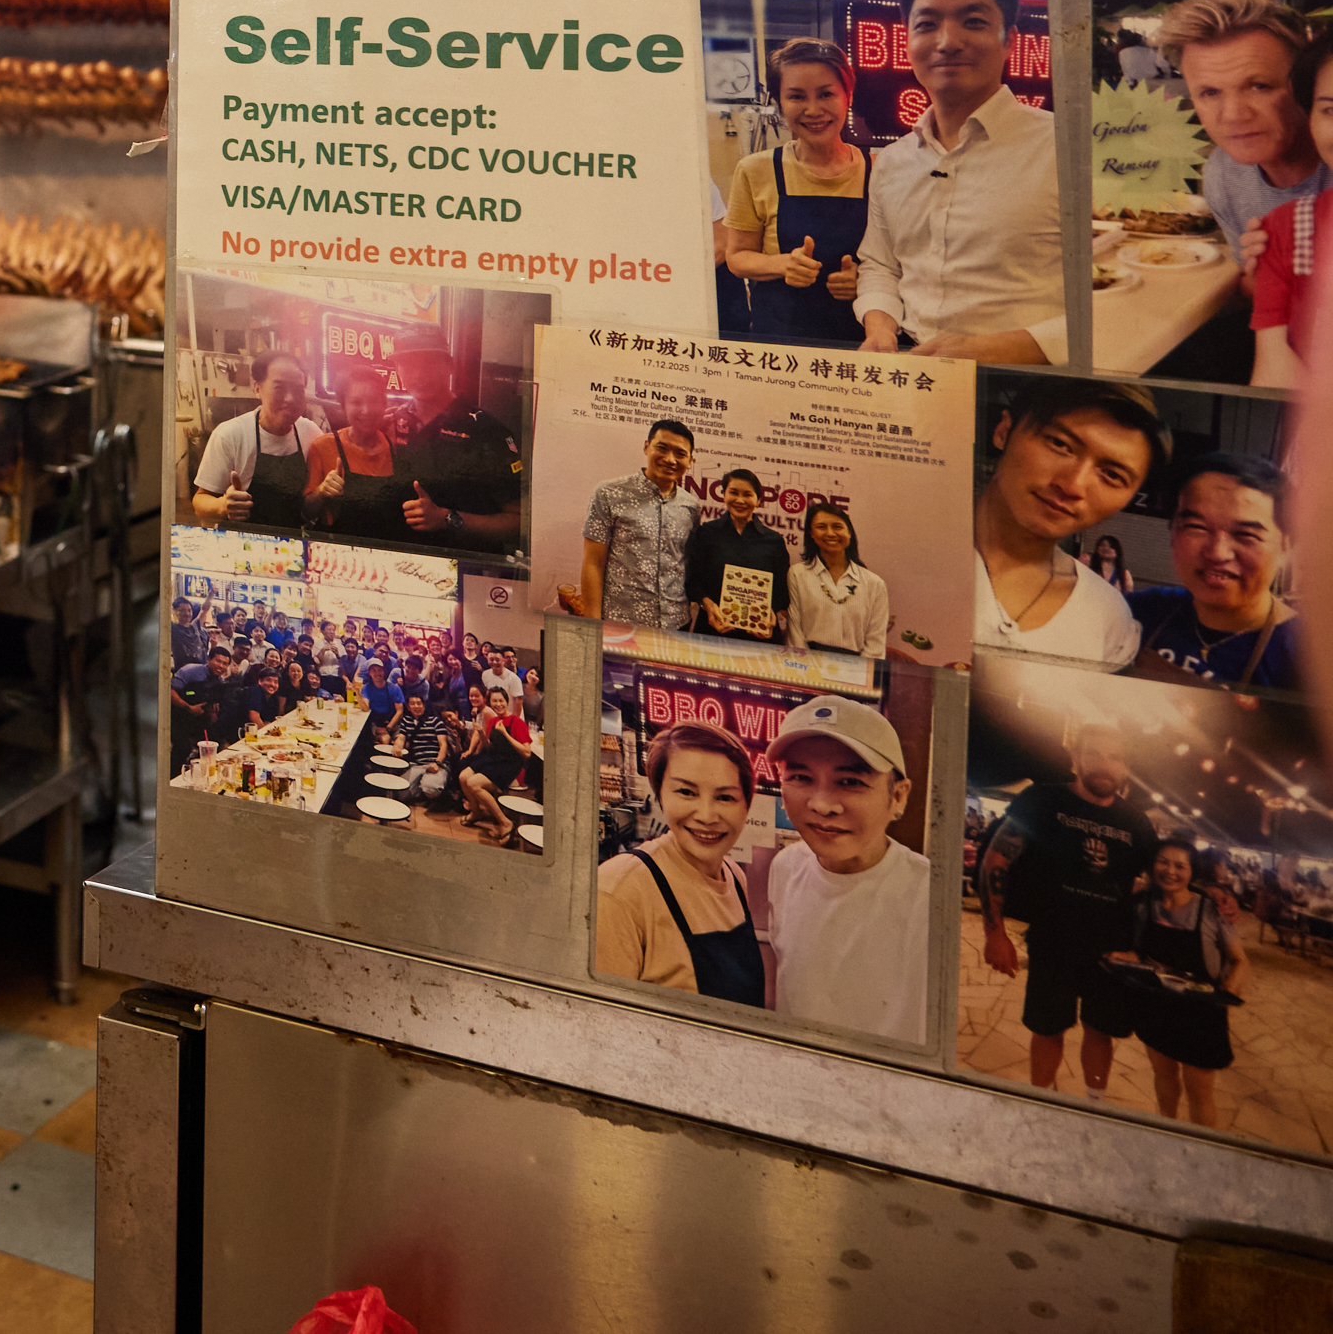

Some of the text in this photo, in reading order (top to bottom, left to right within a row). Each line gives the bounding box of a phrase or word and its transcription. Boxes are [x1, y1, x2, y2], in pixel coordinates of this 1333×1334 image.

[224, 15, 684, 74] Self-Service
[222, 95, 497, 136] Payment accept:
[1092, 112, 1148, 143] Gordon
[221, 139, 638, 179] CASH, NETS, CDC VOUCHER
[1102, 157, 1161, 181] Ramsay
[221, 185, 522, 223] VISA/MASTER CARD
[222, 231, 673, 284] No provide extra empty plate
[328, 325, 374, 360] BBQ
[589, 328, 936, 392] 《新加坡小贩文化》 特辑发布会
[590, 382, 608, 393] Mr
[611, 385, 647, 399] David
[651, 391, 677, 403] Neo
[642, 358, 873, 397] 17.12.2025 3pm Taman Jurong Community Club
[590, 402, 608, 412] Youth
[594, 394, 614, 405] Acting
[790, 412, 873, 431] Ms Goh Hanyan
[785, 492, 800, 502] SG
[785, 500, 800, 510] 60
[726, 584, 768, 599] SINGAPORE
[783, 658, 809, 672] Satay
[647, 687, 724, 728] BBQ
